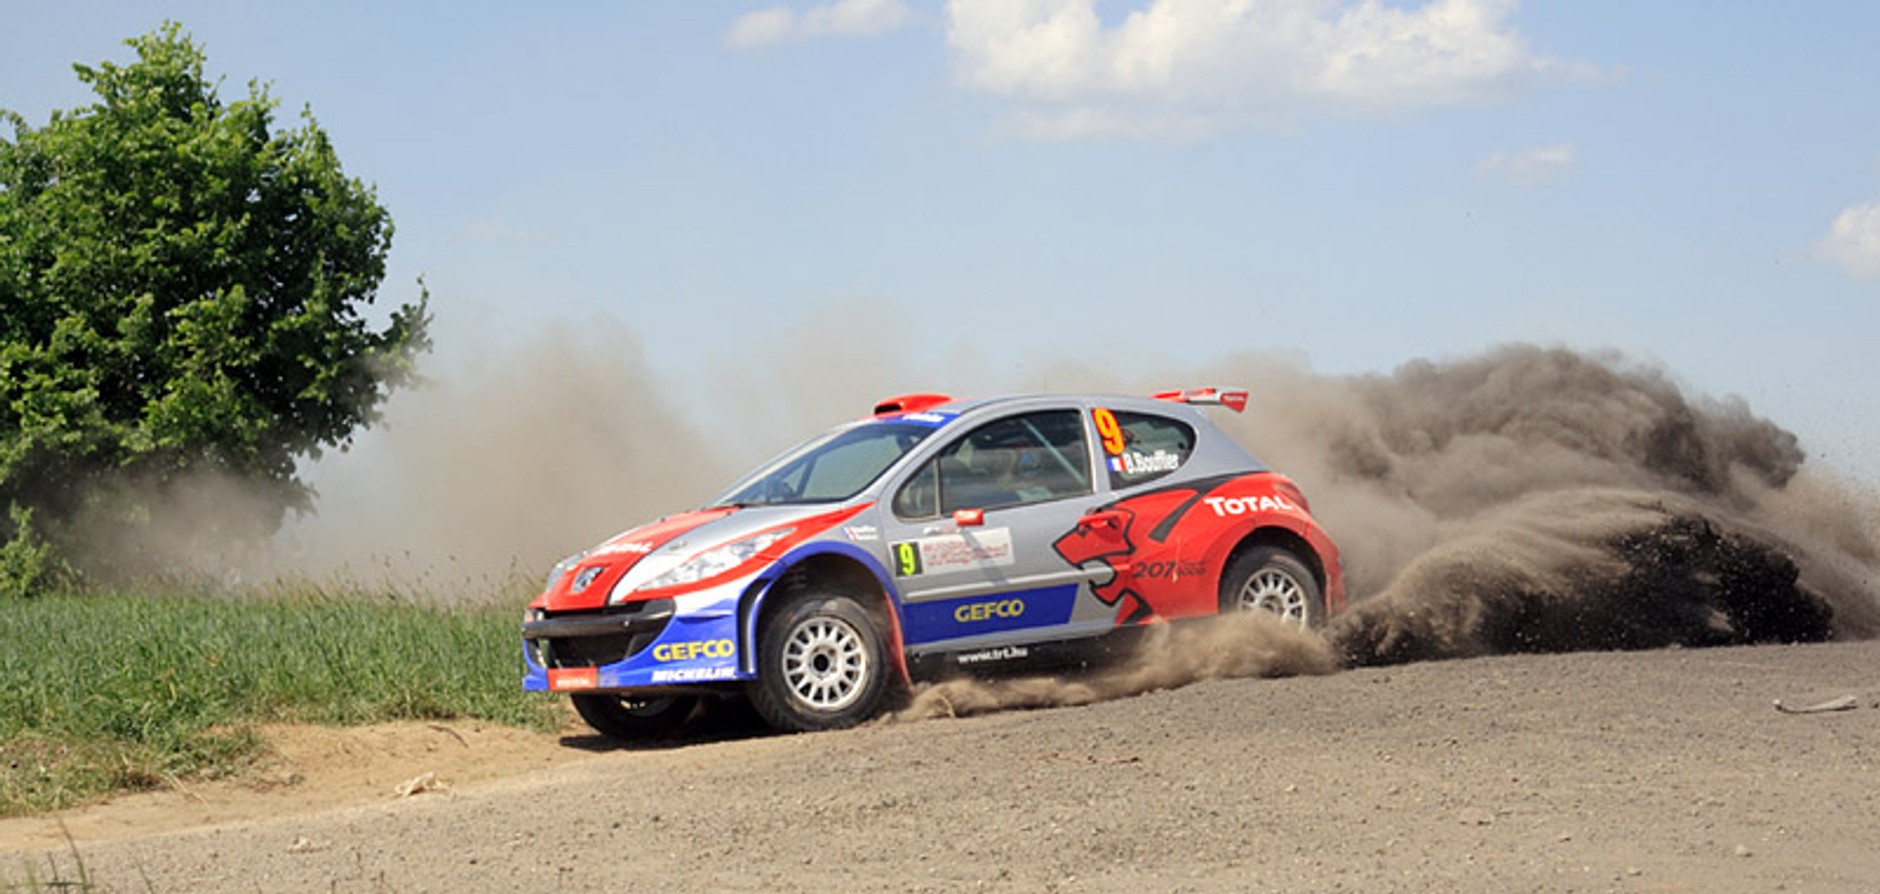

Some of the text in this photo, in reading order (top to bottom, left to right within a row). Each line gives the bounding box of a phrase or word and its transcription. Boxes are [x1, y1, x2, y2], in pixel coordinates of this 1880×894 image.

[1091, 408, 1126, 455] 9
[1203, 495, 1292, 516] TOTAL
[899, 543, 915, 576] 9
[1133, 561, 1176, 578] 207
[954, 598, 1024, 622] GEFCO
[652, 638, 735, 662] GEFCO
